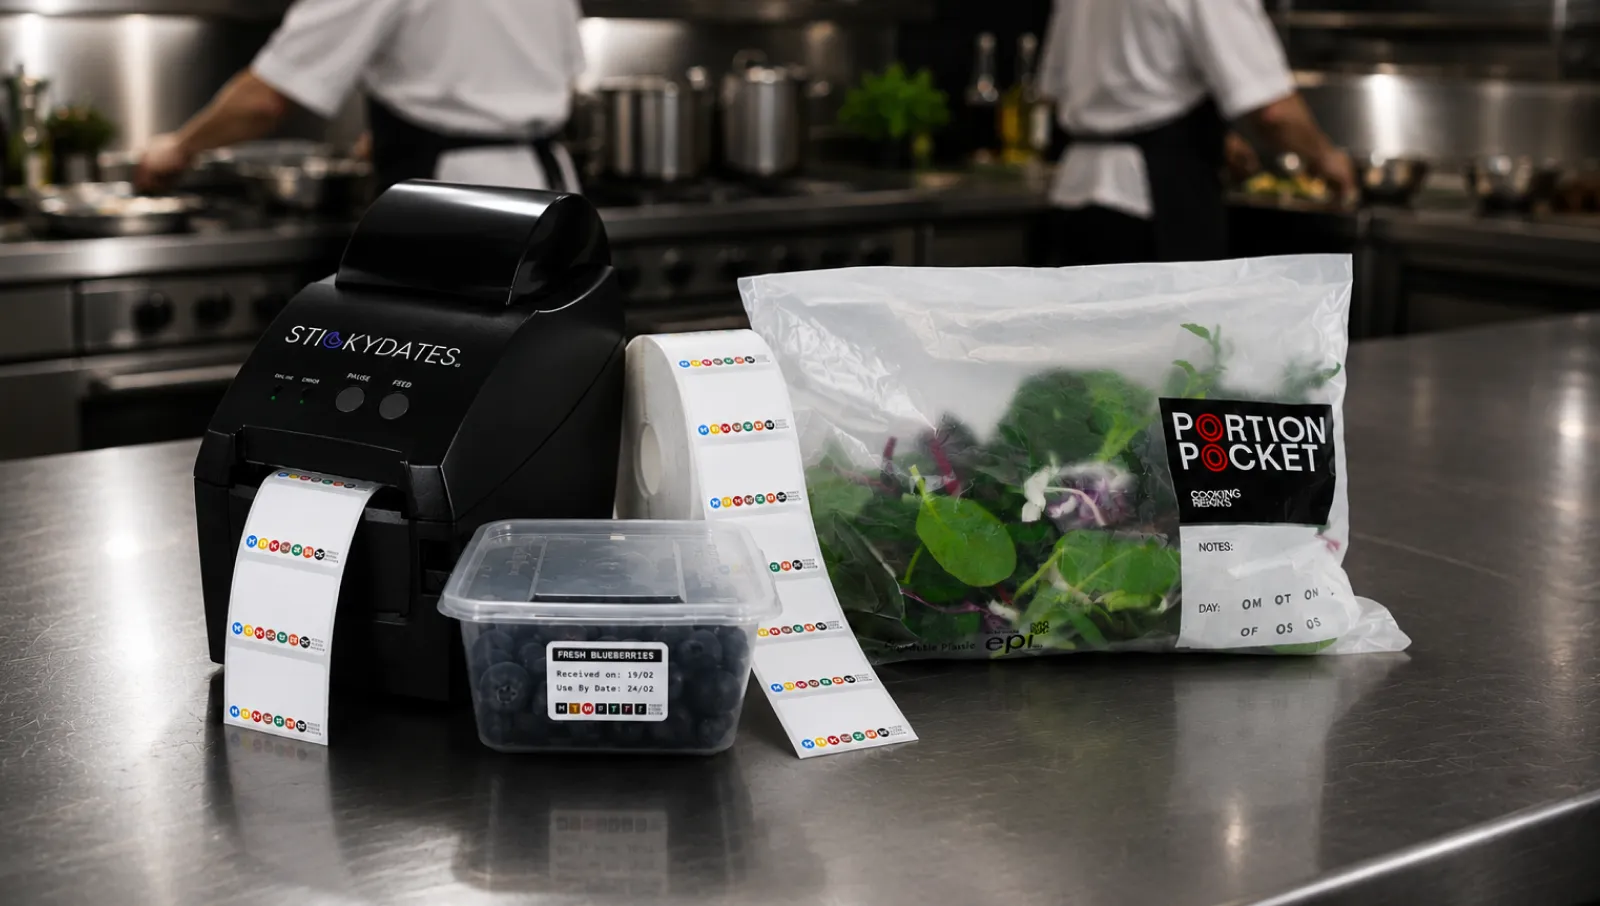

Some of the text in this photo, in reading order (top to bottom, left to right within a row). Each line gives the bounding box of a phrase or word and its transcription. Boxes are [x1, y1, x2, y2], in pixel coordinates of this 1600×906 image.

[346, 372, 371, 383] PAUSE
[392, 379, 412, 388] FEED
[1172, 412, 1326, 444] PORTION
[1179, 442, 1318, 472] POCKET
[1198, 542, 1233, 552] NOTES:
[1198, 603, 1221, 613] DAY:
[557, 650, 654, 660] FRESH BLUEBERRIES
[556, 670, 600, 678] Received
[627, 671, 654, 679] 19/02
[556, 684, 654, 693] Use By Date: 24/02
